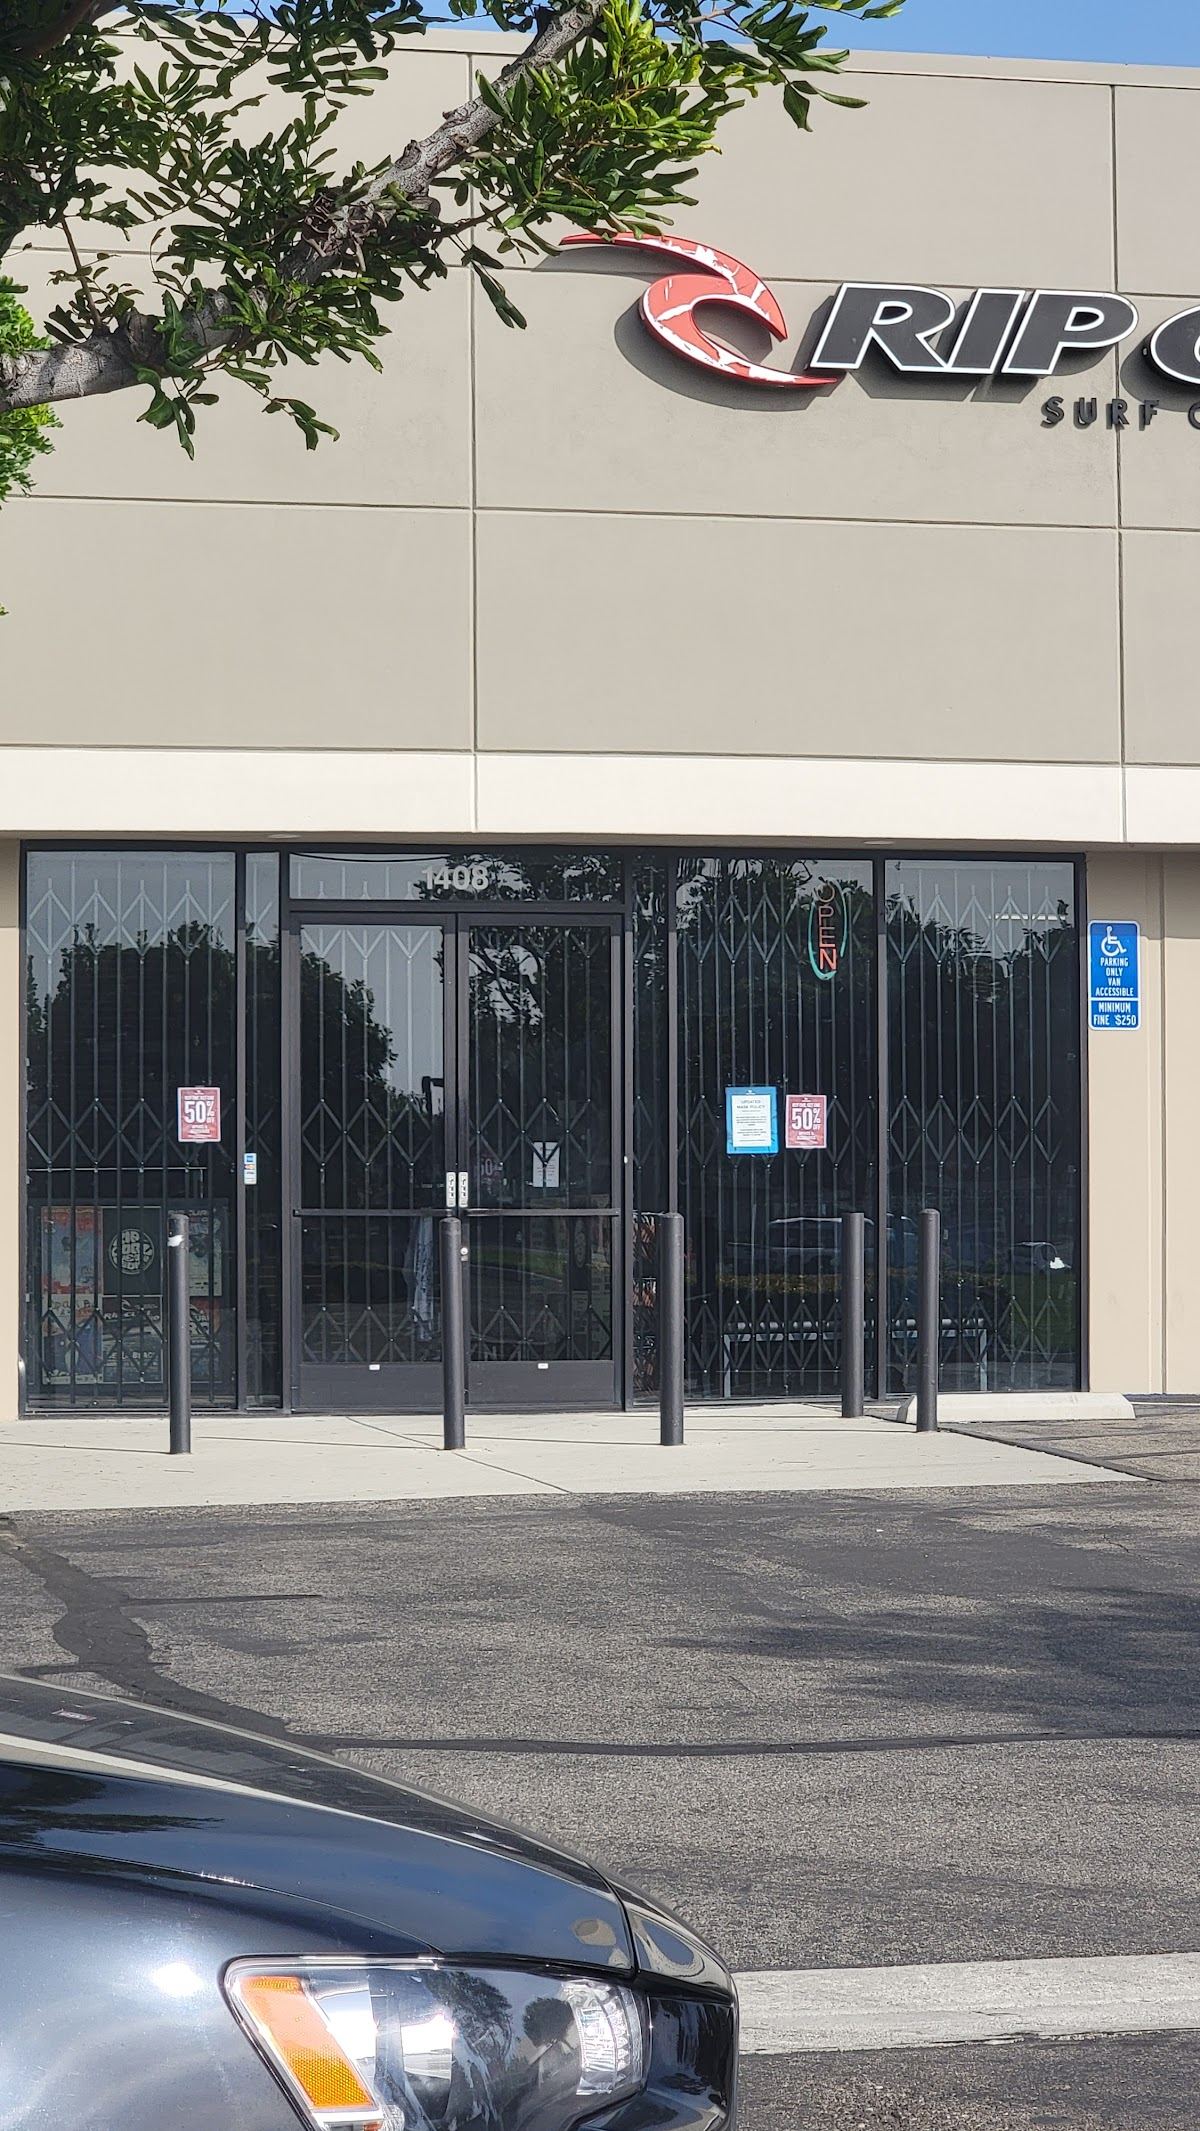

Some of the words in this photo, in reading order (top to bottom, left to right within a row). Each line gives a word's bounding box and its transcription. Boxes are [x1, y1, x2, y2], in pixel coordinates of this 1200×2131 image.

[810, 281, 1139, 376] RIP
[1041, 395, 1160, 429] SURF
[422, 865, 489, 890] 1408
[817, 882, 837, 970] OPEN
[1100, 957, 1129, 967] PARKING
[1105, 967, 1123, 977] ONLY
[1107, 977, 1121, 987] VAN
[1095, 987, 1134, 997] ACCESSIBLE
[1098, 1002, 1131, 1013] MINIMUM
[1093, 1014, 1110, 1026] FINE
[1115, 1014, 1137, 1026] $250
[184, 1100, 215, 1123] 50%
[791, 1107, 821, 1130] 50%
